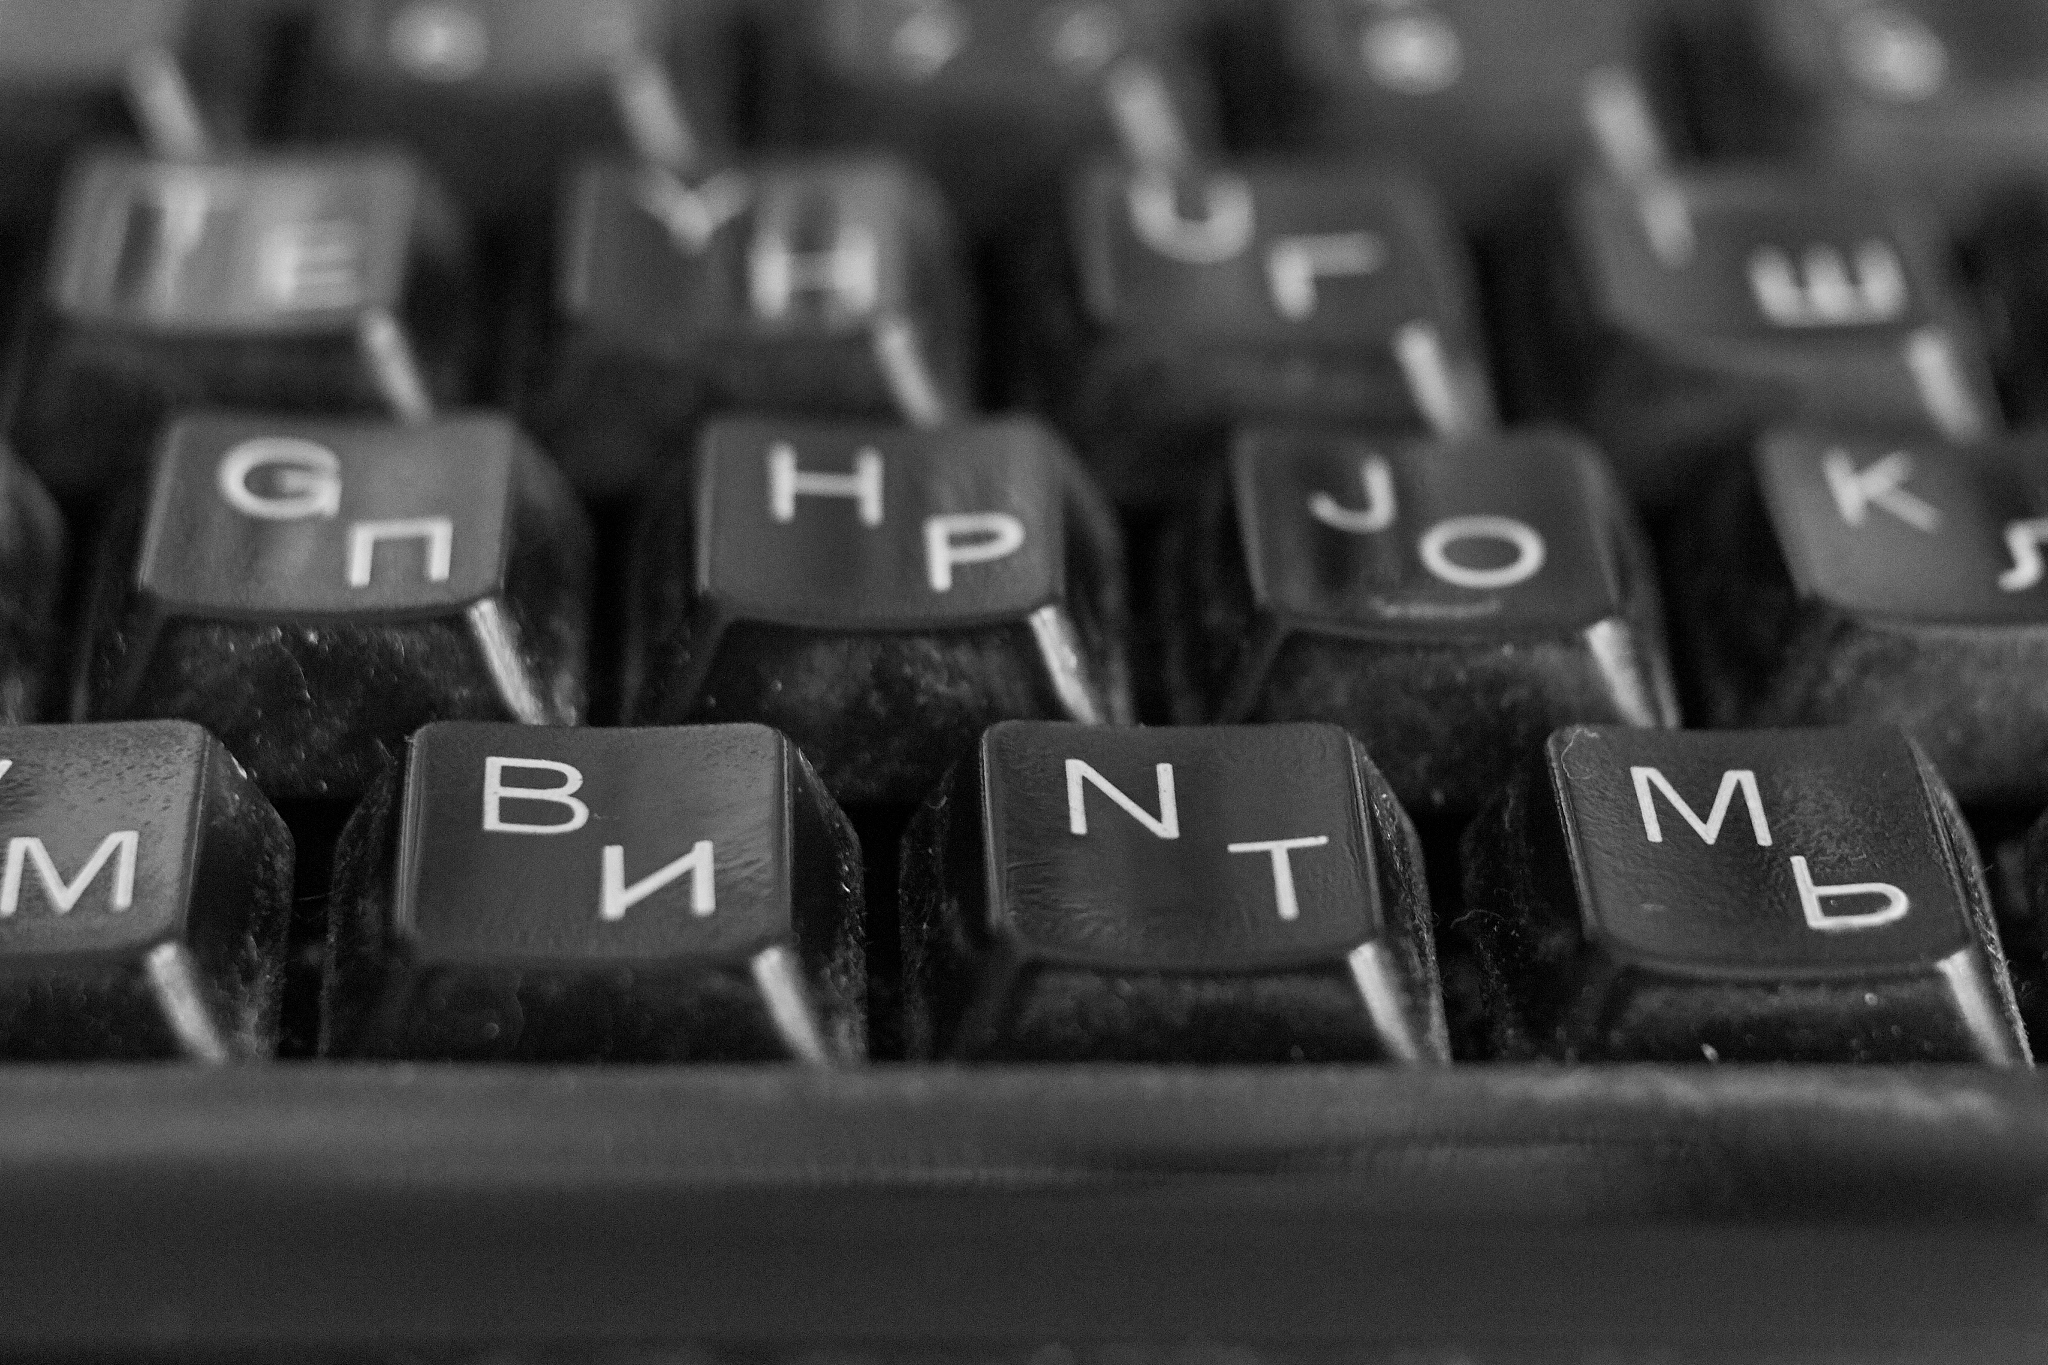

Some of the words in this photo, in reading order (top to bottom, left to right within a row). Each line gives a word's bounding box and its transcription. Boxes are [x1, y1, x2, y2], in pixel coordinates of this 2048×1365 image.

[1126, 172, 1254, 264] U
[219, 437, 342, 519] G
[769, 442, 884, 529] H
[1308, 453, 1396, 533] J
[1822, 447, 1940, 532] K
[348, 517, 454, 587] П
[924, 512, 1025, 592] Р
[482, 756, 590, 834] B
[1065, 758, 1180, 840] N
[1630, 766, 1773, 847] M
[601, 840, 716, 921] И
[1227, 835, 1329, 921] Т
